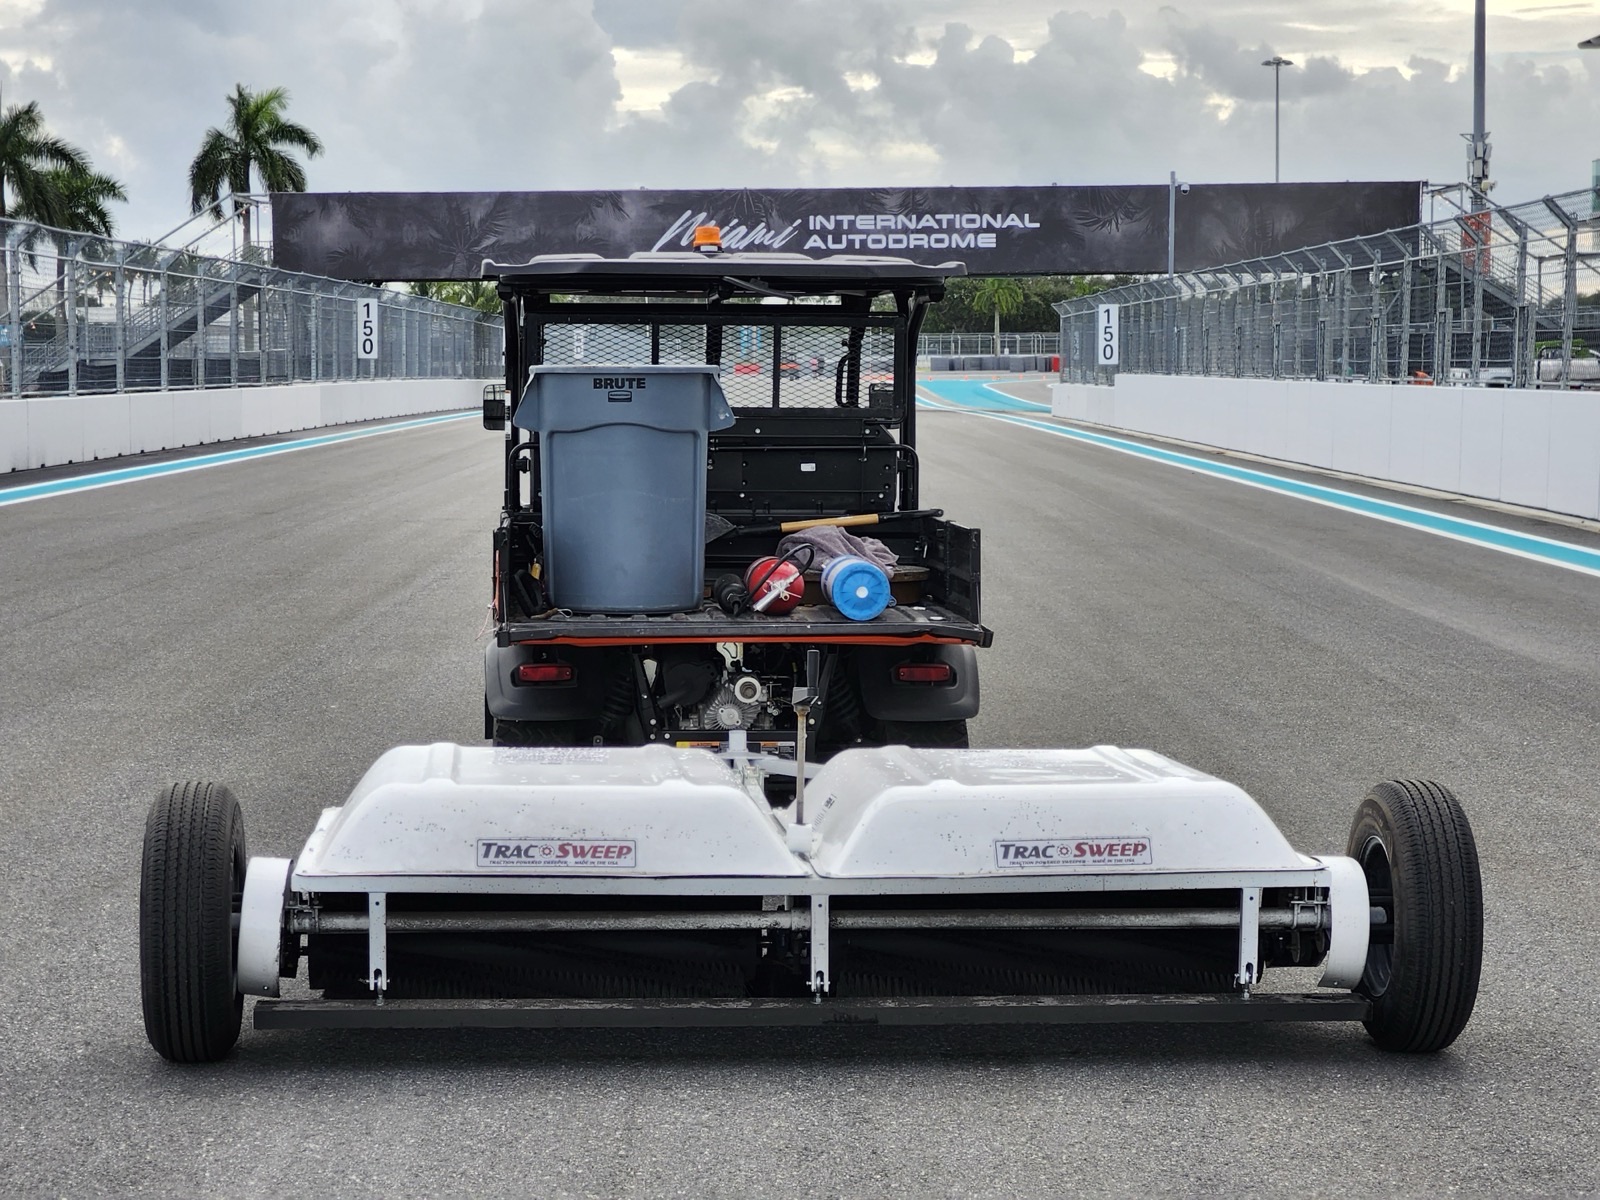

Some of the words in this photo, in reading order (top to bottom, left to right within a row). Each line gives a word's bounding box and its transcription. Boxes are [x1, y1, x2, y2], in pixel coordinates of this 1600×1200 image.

[651, 209, 802, 252] Miami
[809, 213, 1041, 231] INTERNATIONAL
[803, 233, 997, 250] AUTODROME
[363, 303, 373, 355] 150
[1103, 308, 1113, 360] 150
[593, 378, 646, 389] BRUTE
[482, 842, 539, 859] TRAC
[555, 842, 633, 859] SWEEP
[1000, 843, 1056, 860] TRAC
[1073, 841, 1148, 858] SWEEP
